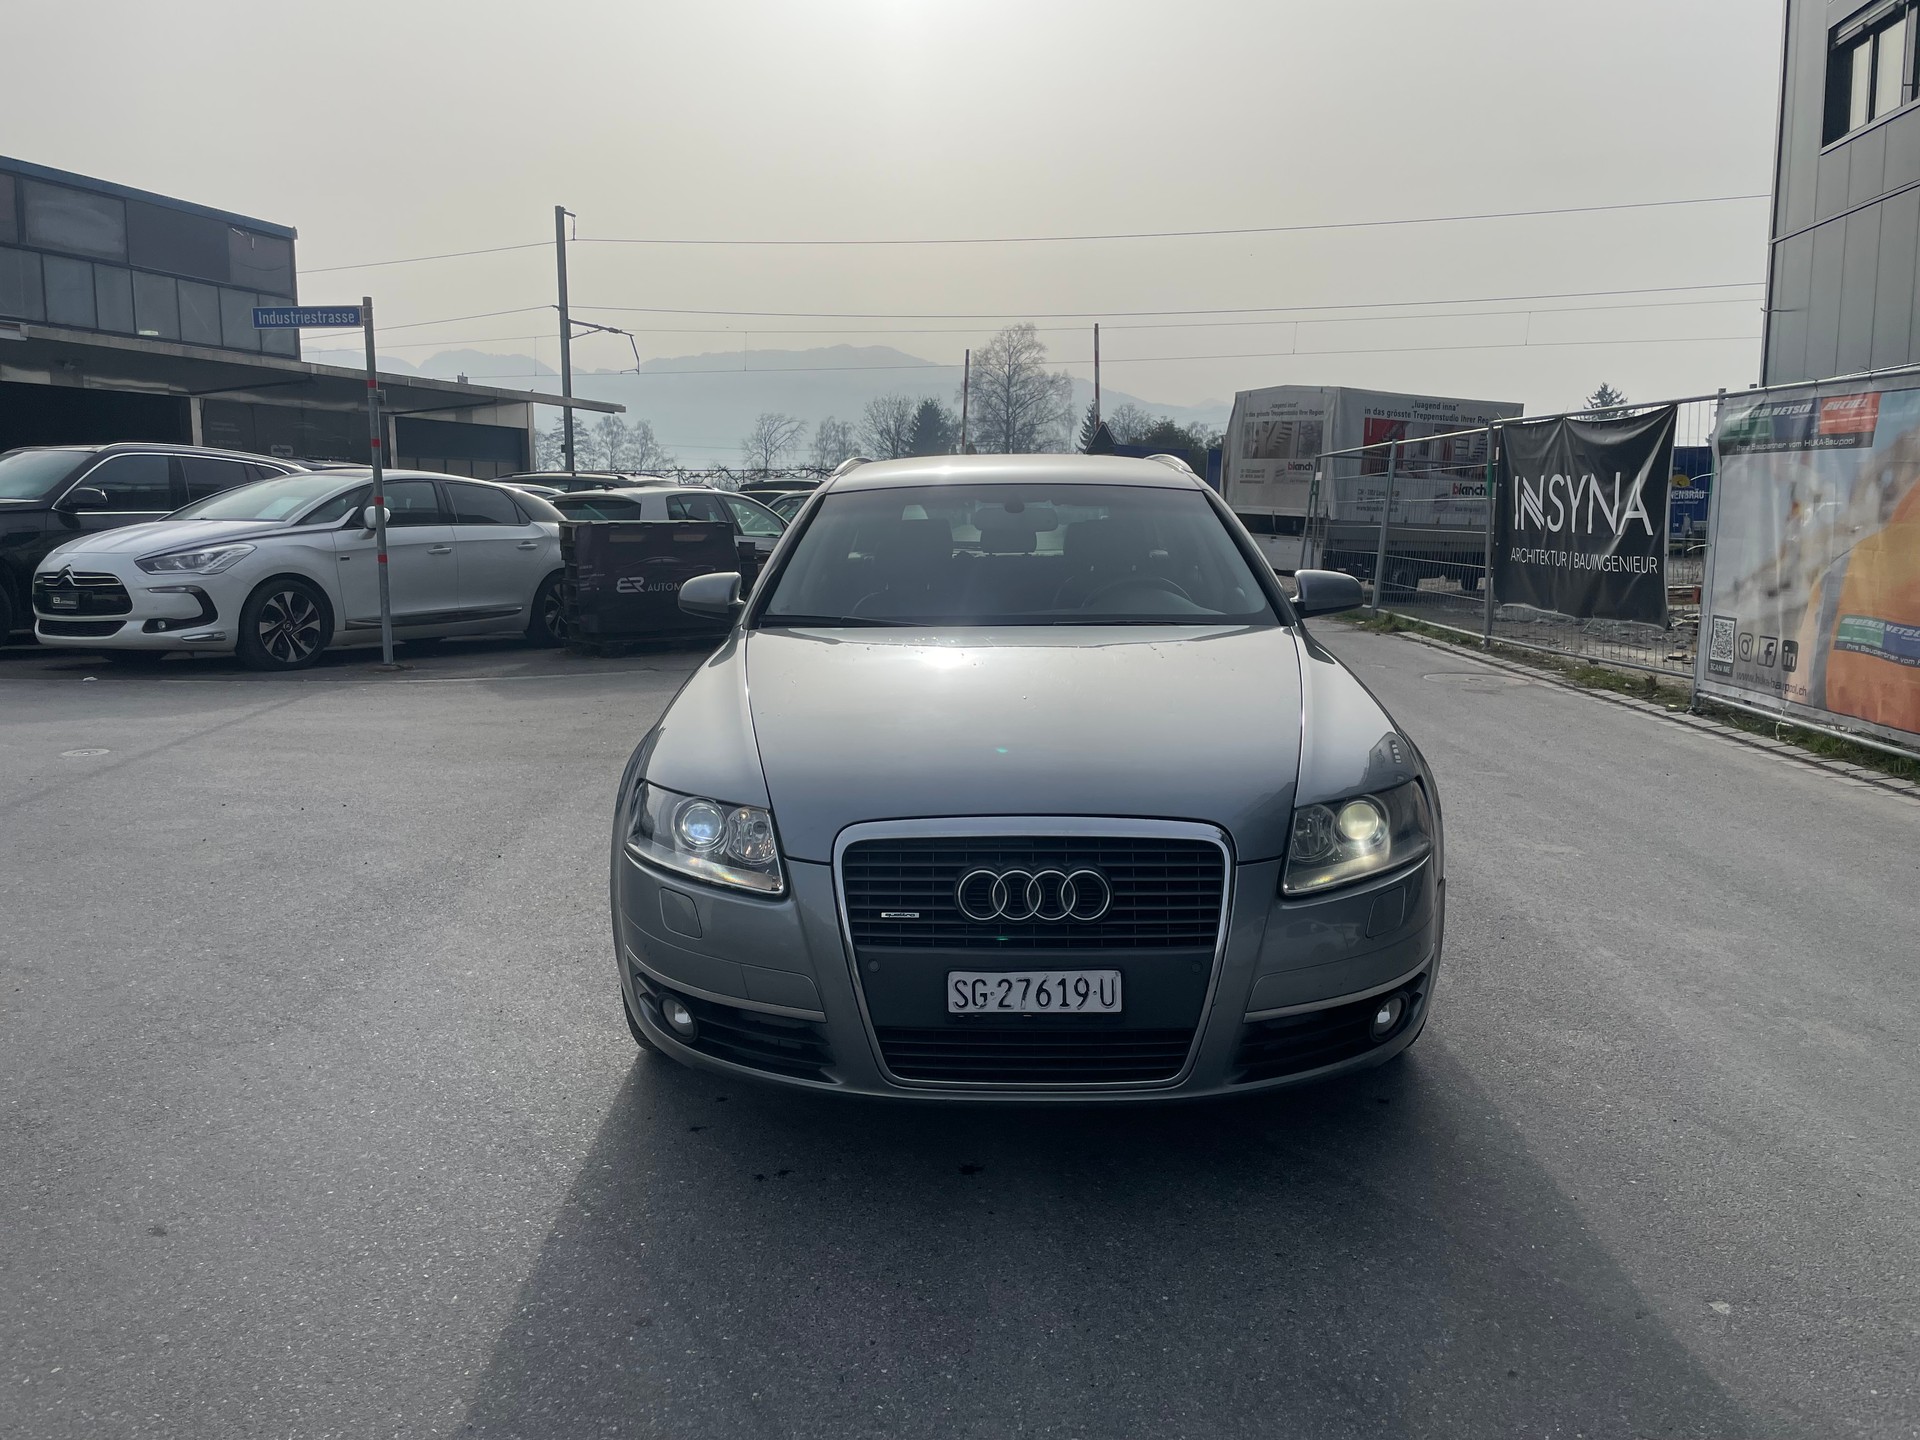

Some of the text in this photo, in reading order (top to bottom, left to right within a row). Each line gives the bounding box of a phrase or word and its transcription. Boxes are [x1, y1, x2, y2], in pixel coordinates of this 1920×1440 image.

[258, 310, 355, 325] Industriestrasse
[1364, 406, 1371, 415] in
[1372, 407, 1385, 416] das
[1413, 410, 1459, 422] Treppenstudio
[1460, 414, 1476, 424] Ihrer
[1514, 471, 1654, 536] INSYNA
[1510, 547, 1658, 574] ARCHITEKTUR BAUINGENIEUR
[1709, 662, 1731, 674] SCAN ME
[1900, 657, 1915, 665] vom
